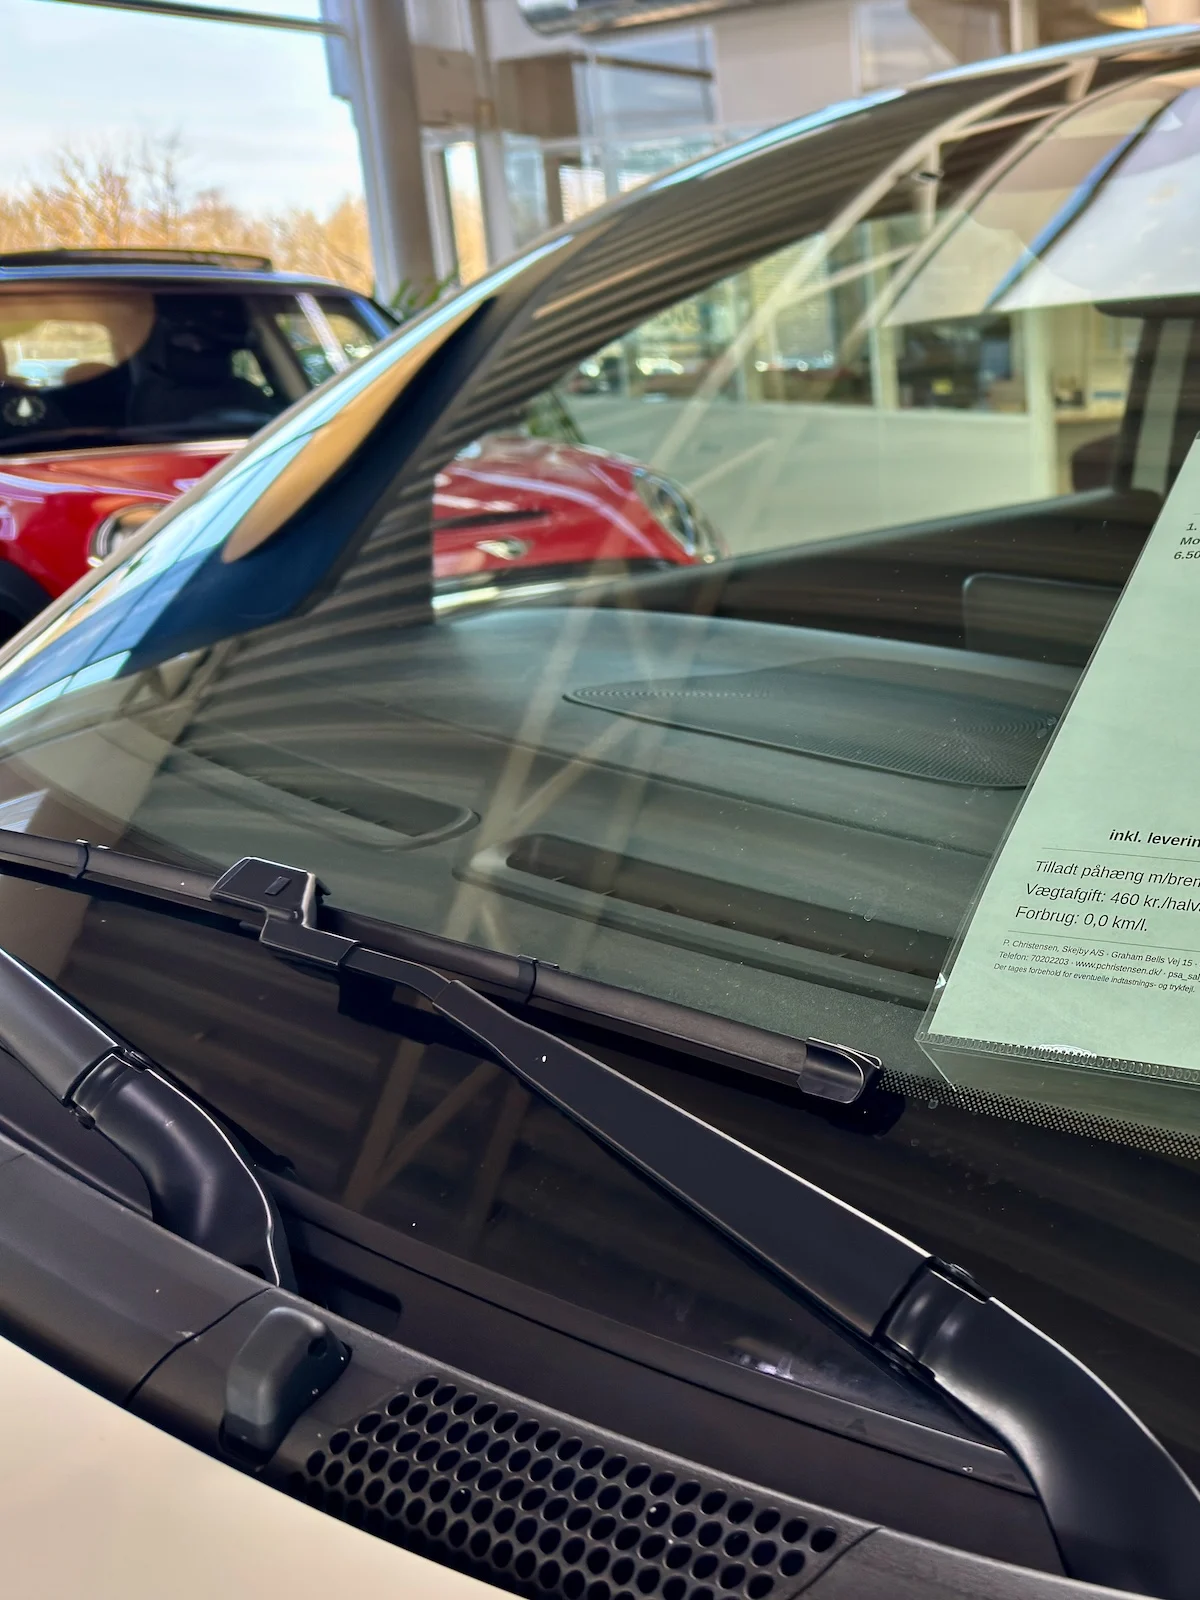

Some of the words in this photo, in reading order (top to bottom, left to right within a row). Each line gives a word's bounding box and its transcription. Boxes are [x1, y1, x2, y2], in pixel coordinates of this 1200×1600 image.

[1186, 523, 1197, 531] 1.
[1109, 829, 1141, 843] inkl.
[1037, 861, 1079, 875] Tilladt
[1080, 864, 1144, 885] påhæng
[1027, 883, 1106, 903] Vægtafgift:
[1110, 892, 1140, 906] 460
[1016, 906, 1079, 926] Forbrug:
[1084, 914, 1108, 928] 0,0
[1112, 916, 1147, 931] km/l.
[1000, 951, 1029, 961] Telefon:
[1031, 955, 1069, 966] 70202203
[1076, 961, 1163, 976] www.pchristensen.dk/
[1012, 941, 1059, 952] Christensen,
[1062, 946, 1089, 956] Skejby
[1089, 949, 1105, 957] A/S
[1111, 951, 1143, 961] Graham
[1145, 955, 1165, 963] Bells
[1168, 957, 1181, 967] Vej
[1182, 959, 1193, 967] 15
